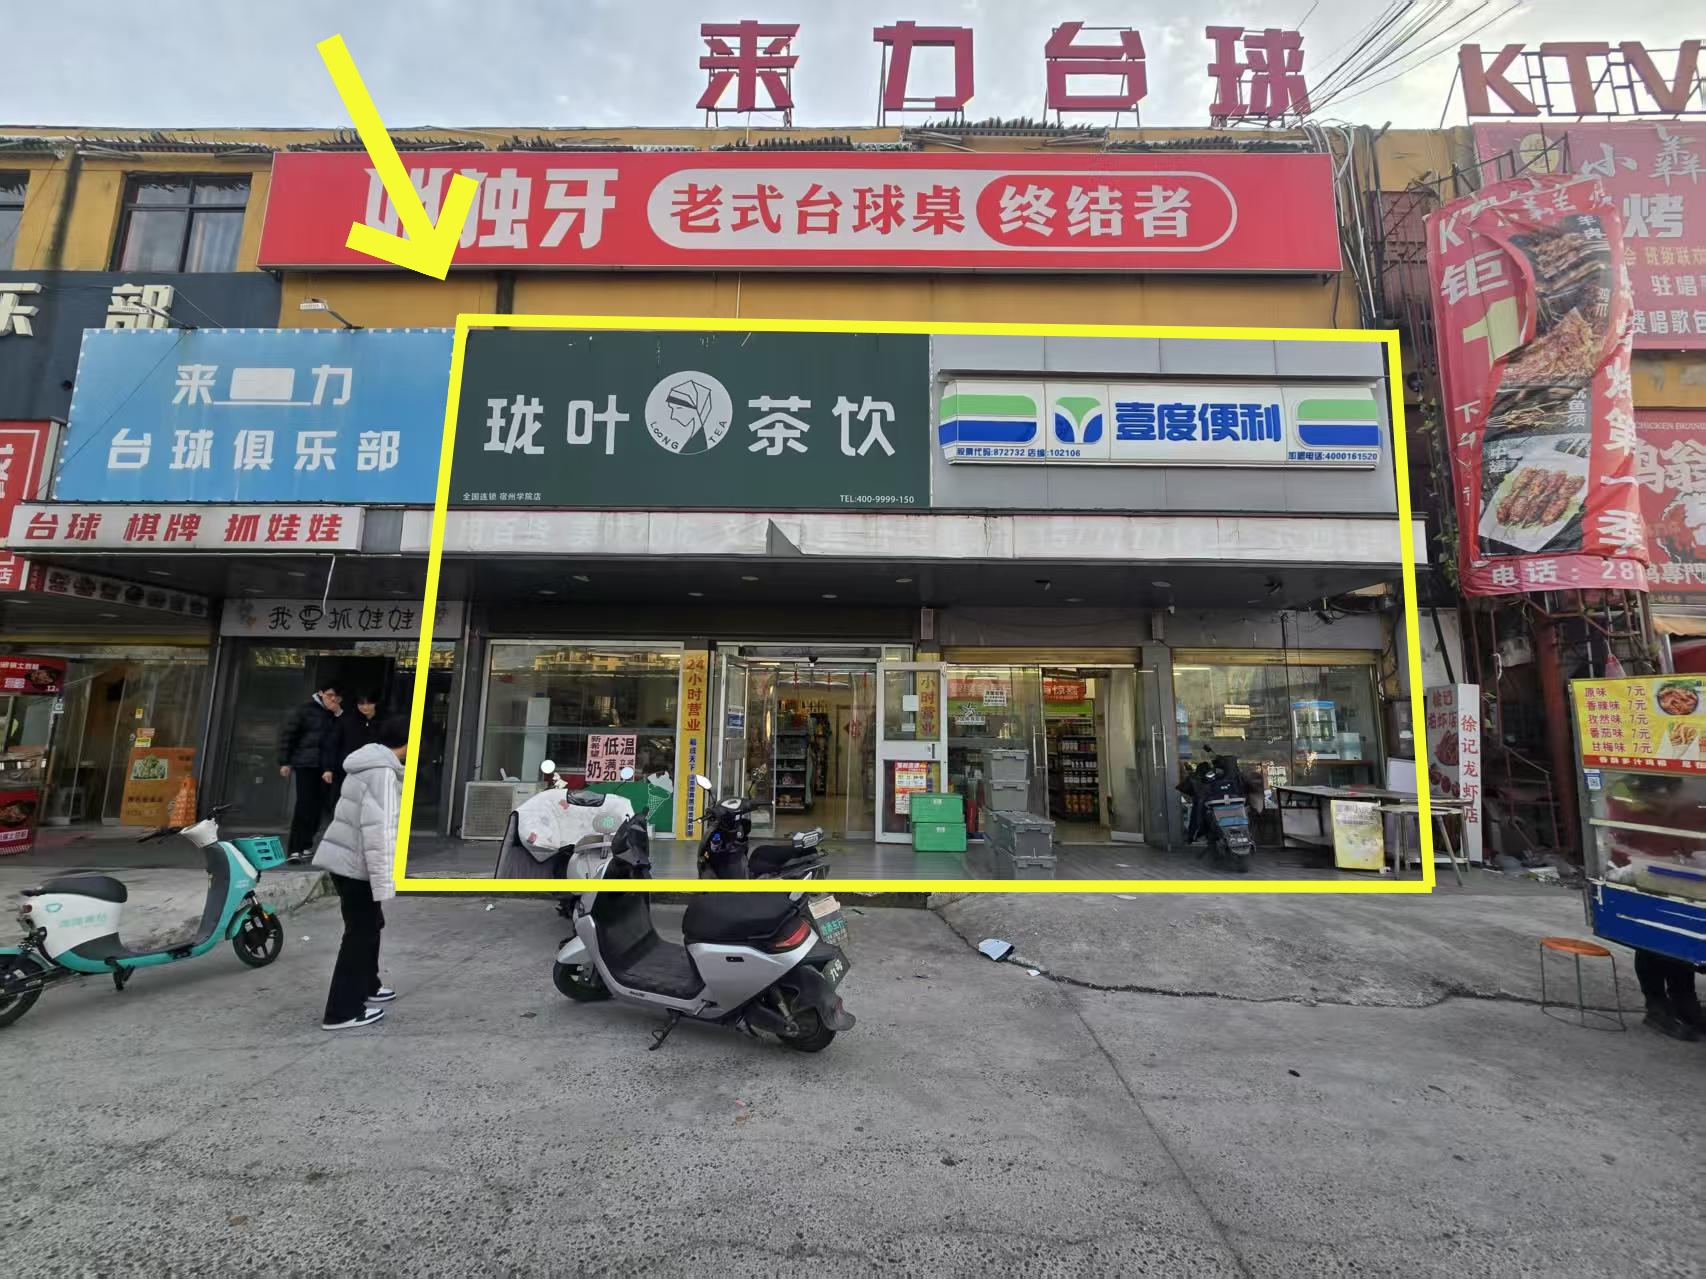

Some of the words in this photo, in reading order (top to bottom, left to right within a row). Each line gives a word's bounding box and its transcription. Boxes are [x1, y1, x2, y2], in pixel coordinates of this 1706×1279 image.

[1458, 40, 1703, 117] KTV
[669, 183, 965, 236] 老式台球桌
[997, 184, 1192, 238] 终结者
[483, 394, 630, 455] 珑叶
[748, 395, 896, 457] 茶饮
[708, 420, 728, 444] TEA
[1114, 401, 1282, 443] 壹度便利
[107, 427, 401, 472] 台球俱乐部
[839, 494, 915, 505] TEL:400-9999-150
[25, 512, 102, 541] 台球
[122, 513, 202, 542] 棋牌
[223, 513, 343, 543] 抓娃娃
[268, 604, 416, 632] 我要抓娃娃
[604, 737, 635, 756] 低温
[587, 760, 601, 779] 奶
[1461, 714, 1480, 825] 徐记龙虾店
